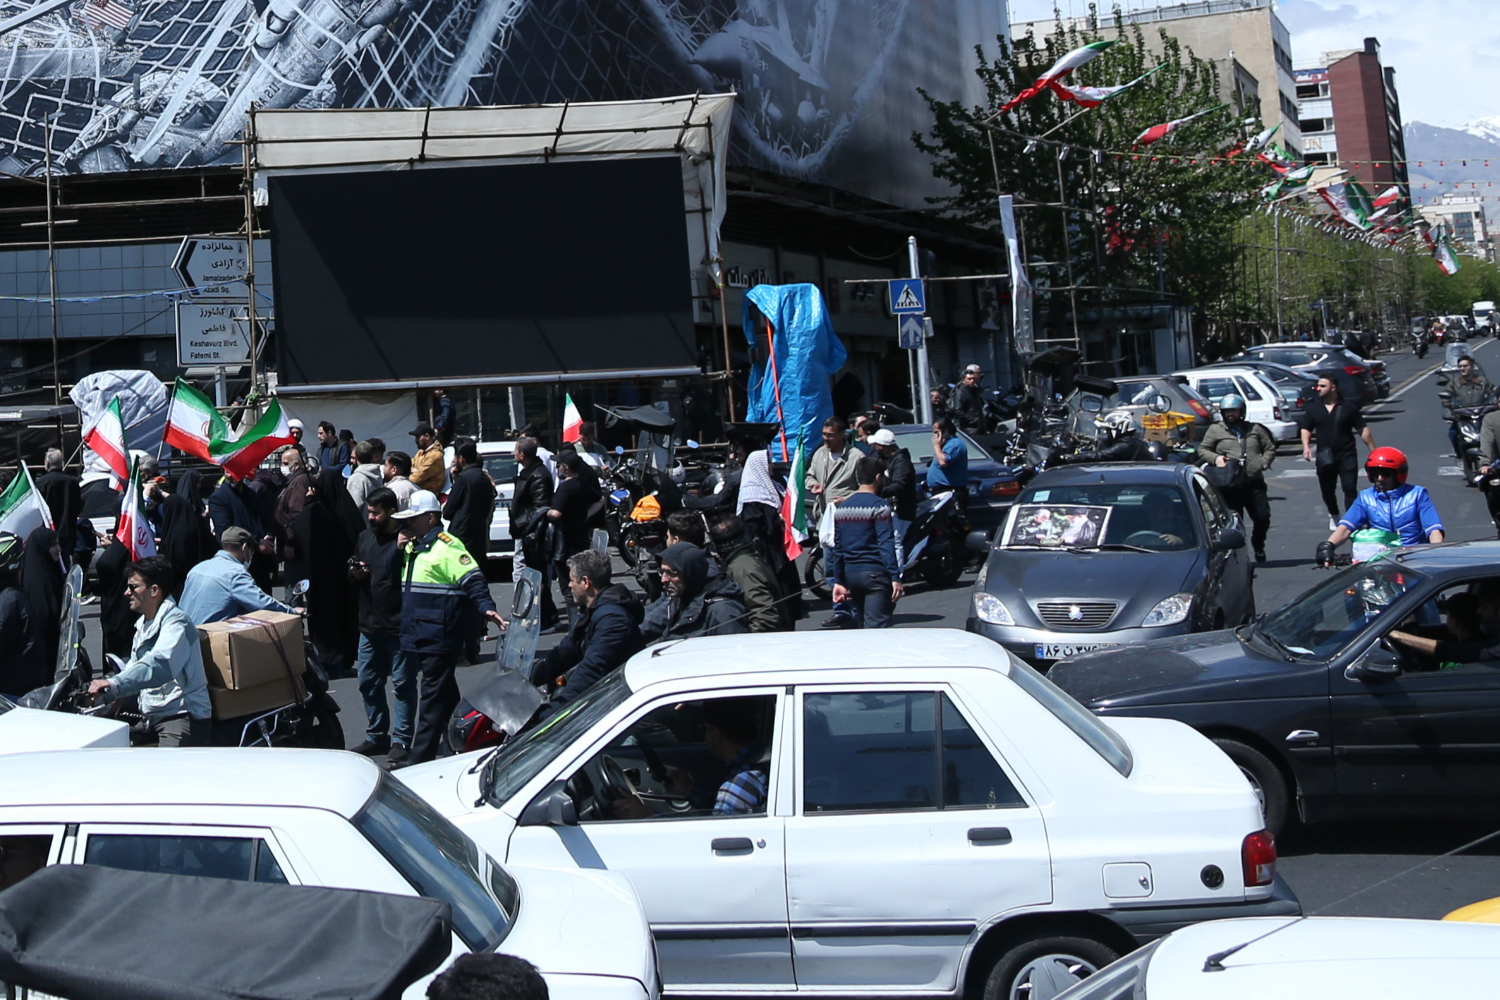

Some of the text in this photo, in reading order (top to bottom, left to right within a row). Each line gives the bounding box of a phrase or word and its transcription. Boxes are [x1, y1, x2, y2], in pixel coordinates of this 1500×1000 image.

[211, 258, 234, 270] آزادی
[200, 307, 226, 318] کشاورز
[201, 324, 226, 335] فاطمی
[1045, 645, 1060, 657] ۸۶
